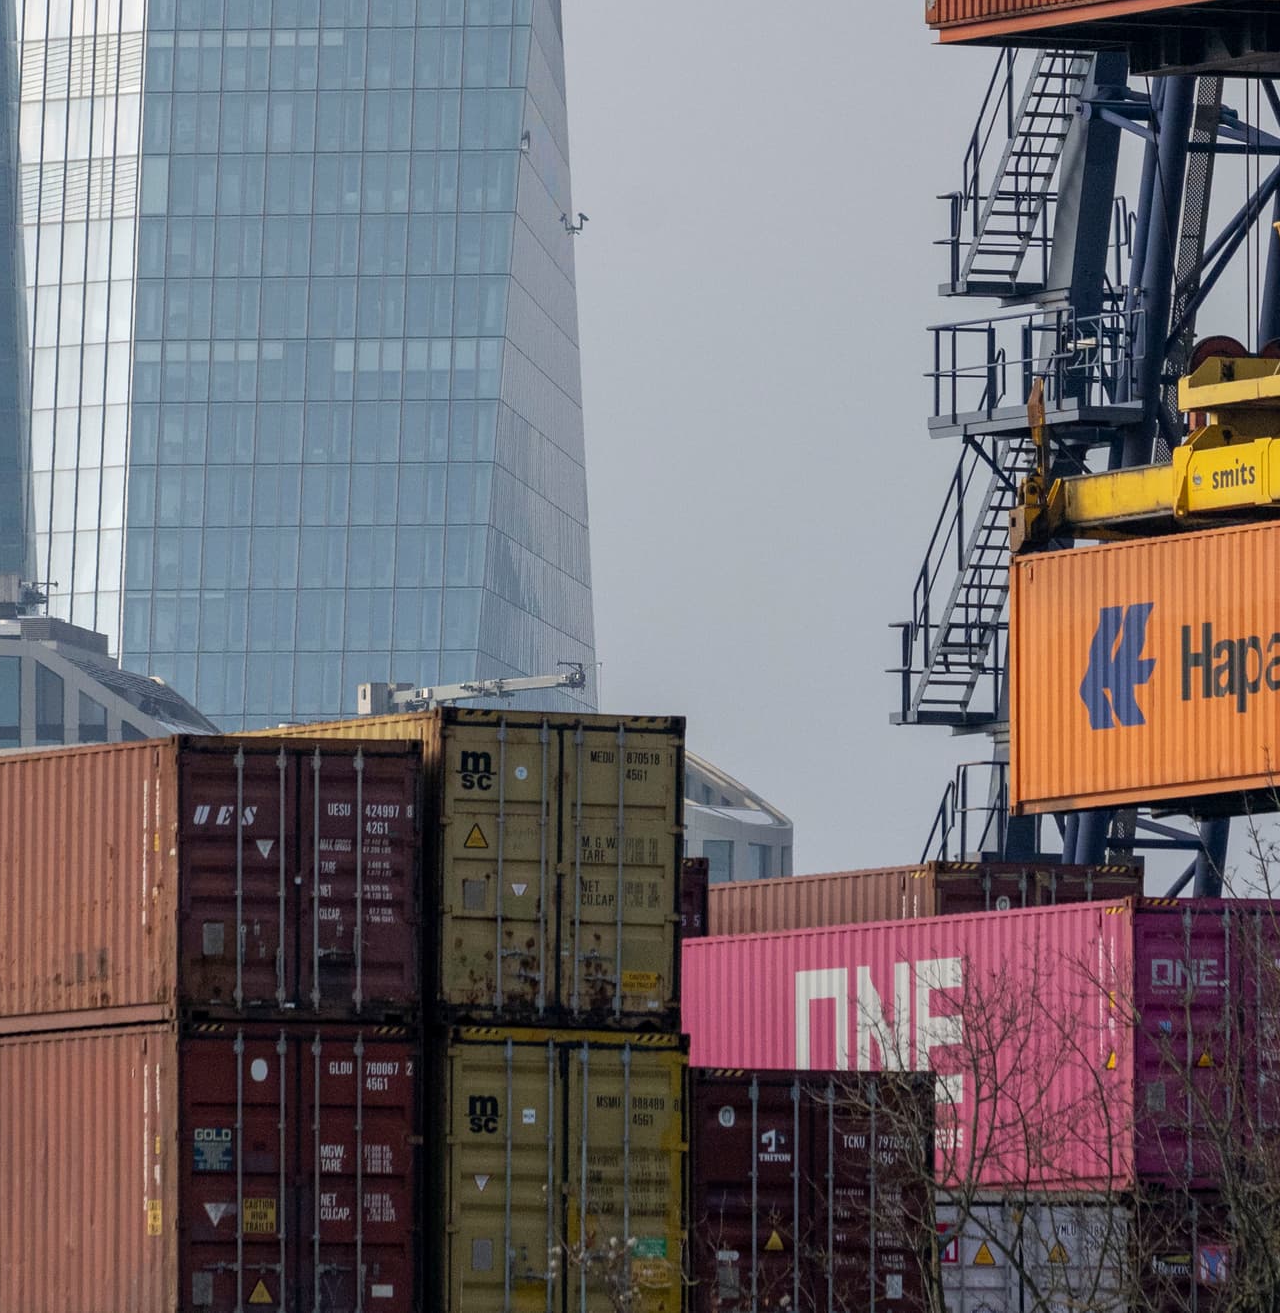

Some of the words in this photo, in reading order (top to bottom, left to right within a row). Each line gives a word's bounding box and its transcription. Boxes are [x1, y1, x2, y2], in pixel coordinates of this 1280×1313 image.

[1212, 458, 1256, 490] smits
[590, 750, 615, 764] MEDU
[626, 751, 660, 765] 870518
[327, 803, 351, 816] UESU
[365, 804, 400, 818] 424997
[365, 821, 389, 835] 42G1
[1151, 958, 1219, 986] ONE
[405, 1062, 413, 1076] 2
[365, 1077, 389, 1091] 45G1
[194, 1128, 232, 1141] GOLD
[843, 1135, 866, 1149] TCKU
[758, 1153, 791, 1162] TRITON
[321, 1159, 342, 1173] TARE
[320, 1193, 337, 1207] NET
